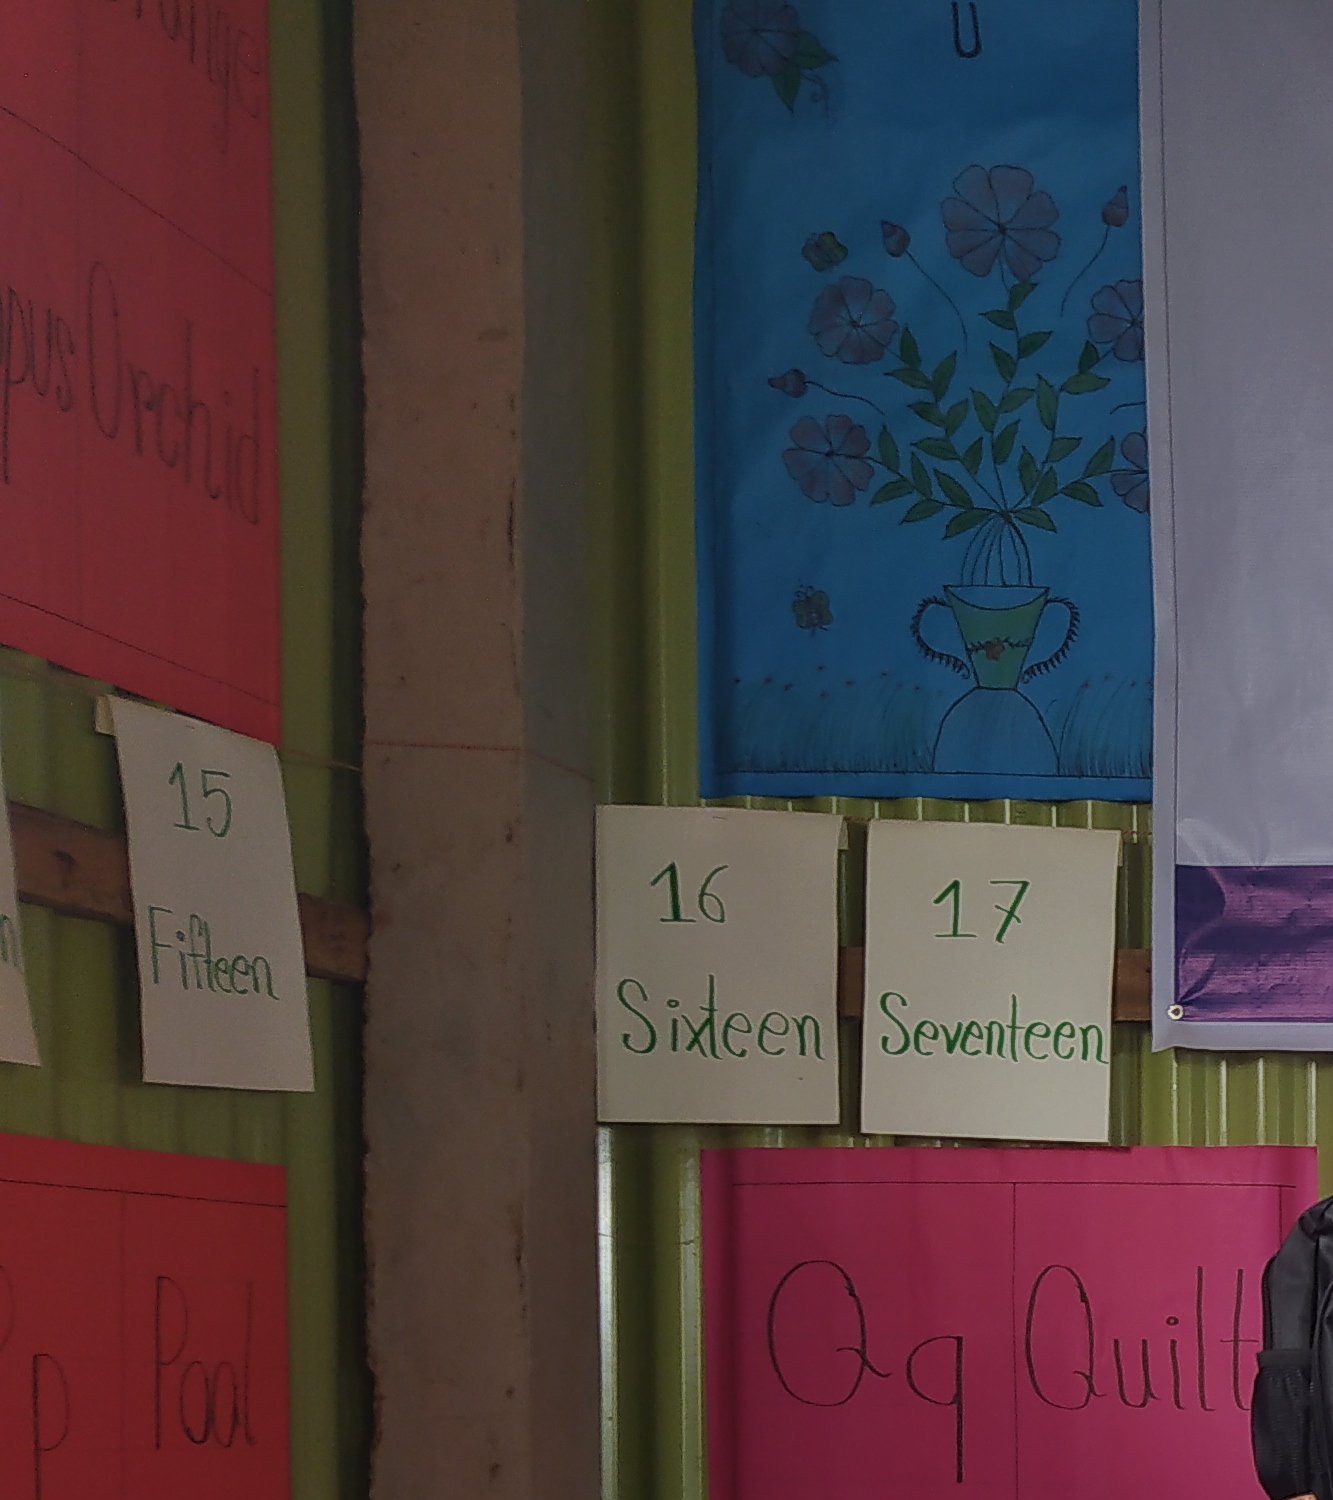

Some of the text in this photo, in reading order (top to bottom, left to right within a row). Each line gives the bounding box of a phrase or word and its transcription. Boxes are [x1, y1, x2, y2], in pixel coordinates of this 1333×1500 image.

[0, 260, 262, 526] pus Orchid
[168, 762, 232, 837] 15
[650, 862, 728, 923] 16
[933, 880, 1029, 943] 17
[149, 906, 280, 1000] Fifteen
[617, 974, 824, 1059] Sixteen
[880, 992, 1108, 1064] Seventeen
[1025, 1264, 1258, 1411] Quilt
